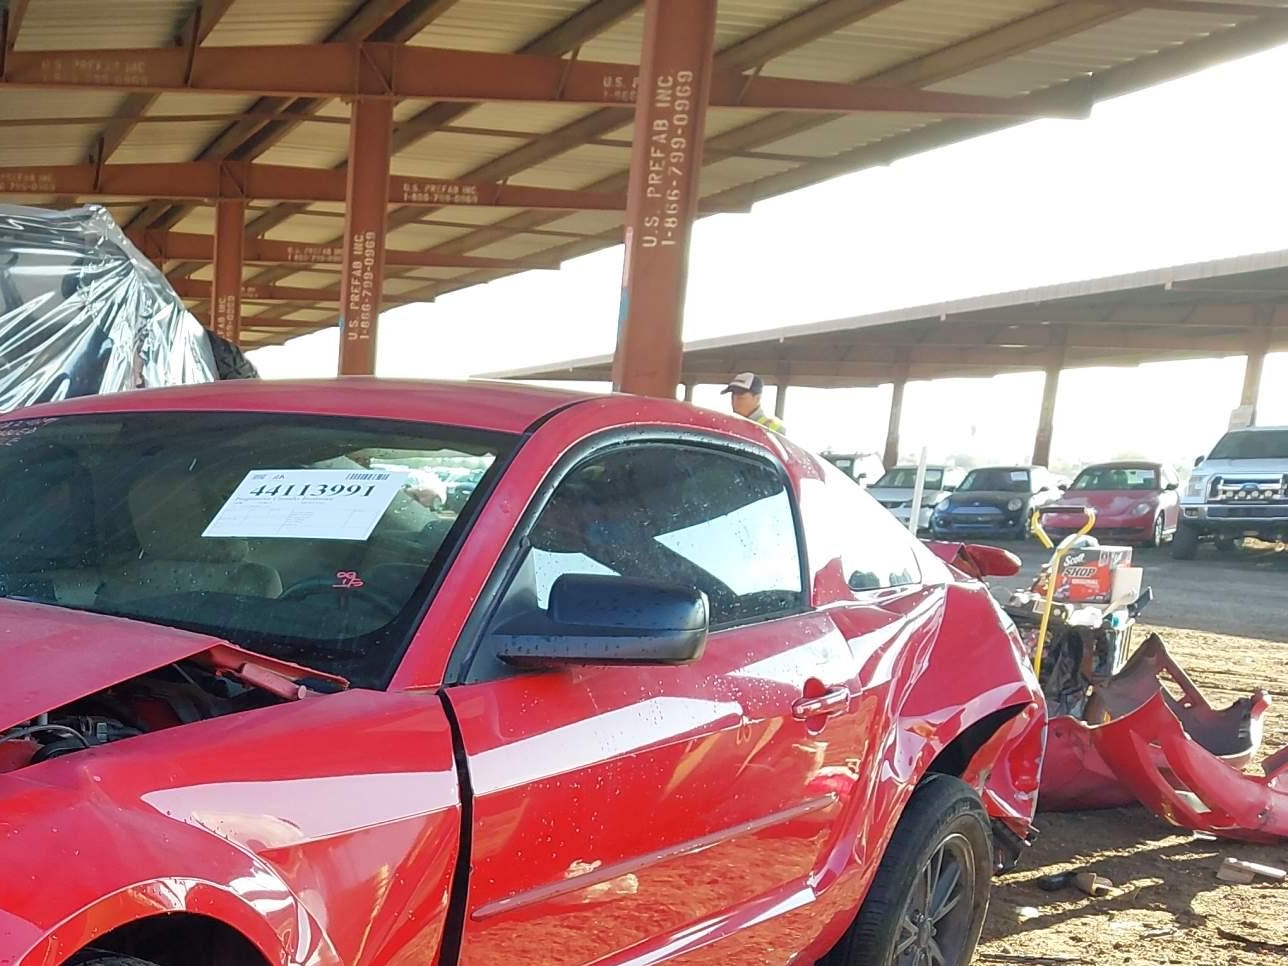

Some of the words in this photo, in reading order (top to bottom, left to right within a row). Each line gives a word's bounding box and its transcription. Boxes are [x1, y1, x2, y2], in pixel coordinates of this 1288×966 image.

[656, 75, 674, 108] INC
[647, 118, 669, 198] PREFAB
[661, 69, 694, 246] 1-866-799-0969
[641, 211, 659, 248] U.S.
[350, 260, 363, 310] PREFAB
[249, 483, 376, 497] 44113991
[1063, 567, 1098, 578] SHOP
